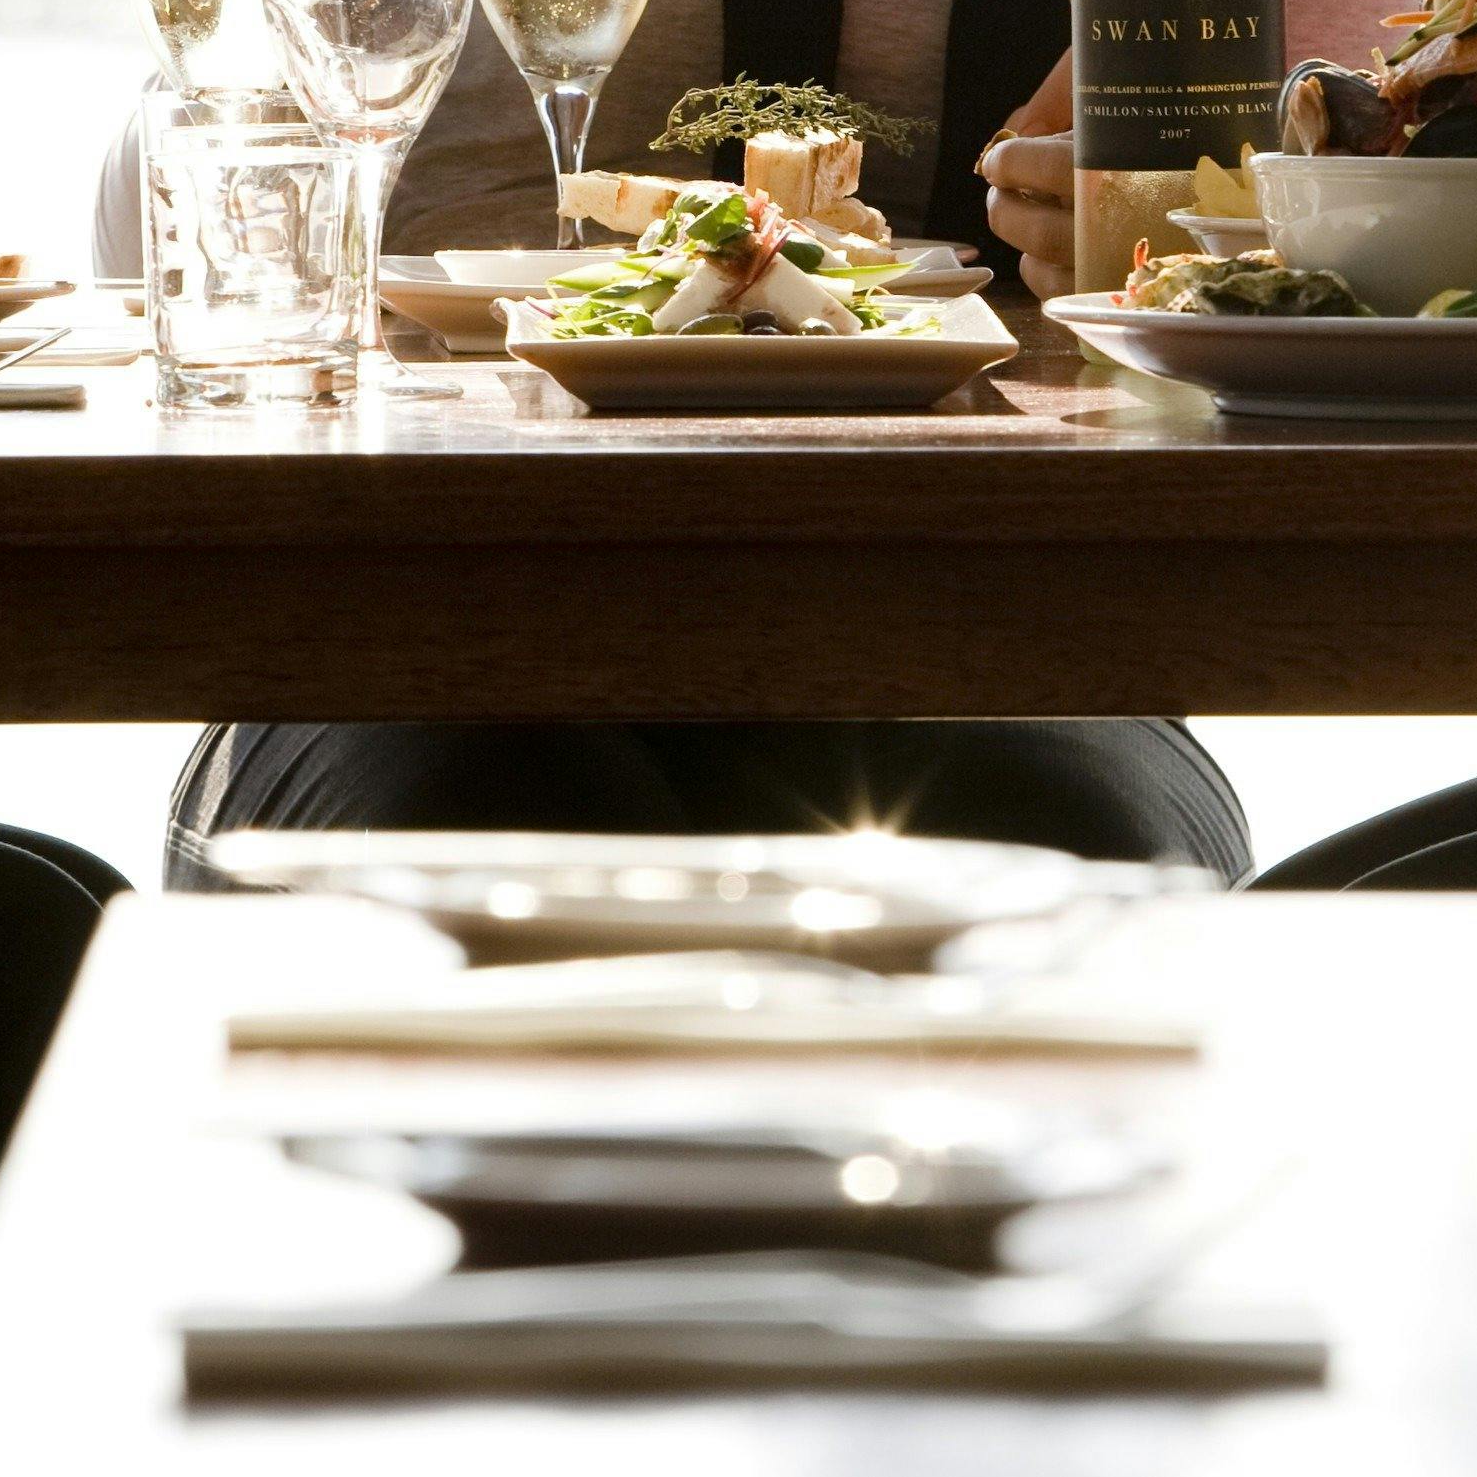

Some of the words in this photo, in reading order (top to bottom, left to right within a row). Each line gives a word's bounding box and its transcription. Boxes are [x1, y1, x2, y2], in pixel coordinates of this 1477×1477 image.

[1092, 19, 1179, 41] SWAN
[1199, 15, 1260, 40] BAY
[1145, 85, 1174, 94] HILLS
[1187, 83, 1247, 93] MORNINGTON
[1237, 102, 1274, 114] BLANC
[1159, 128, 1191, 140] 2007
